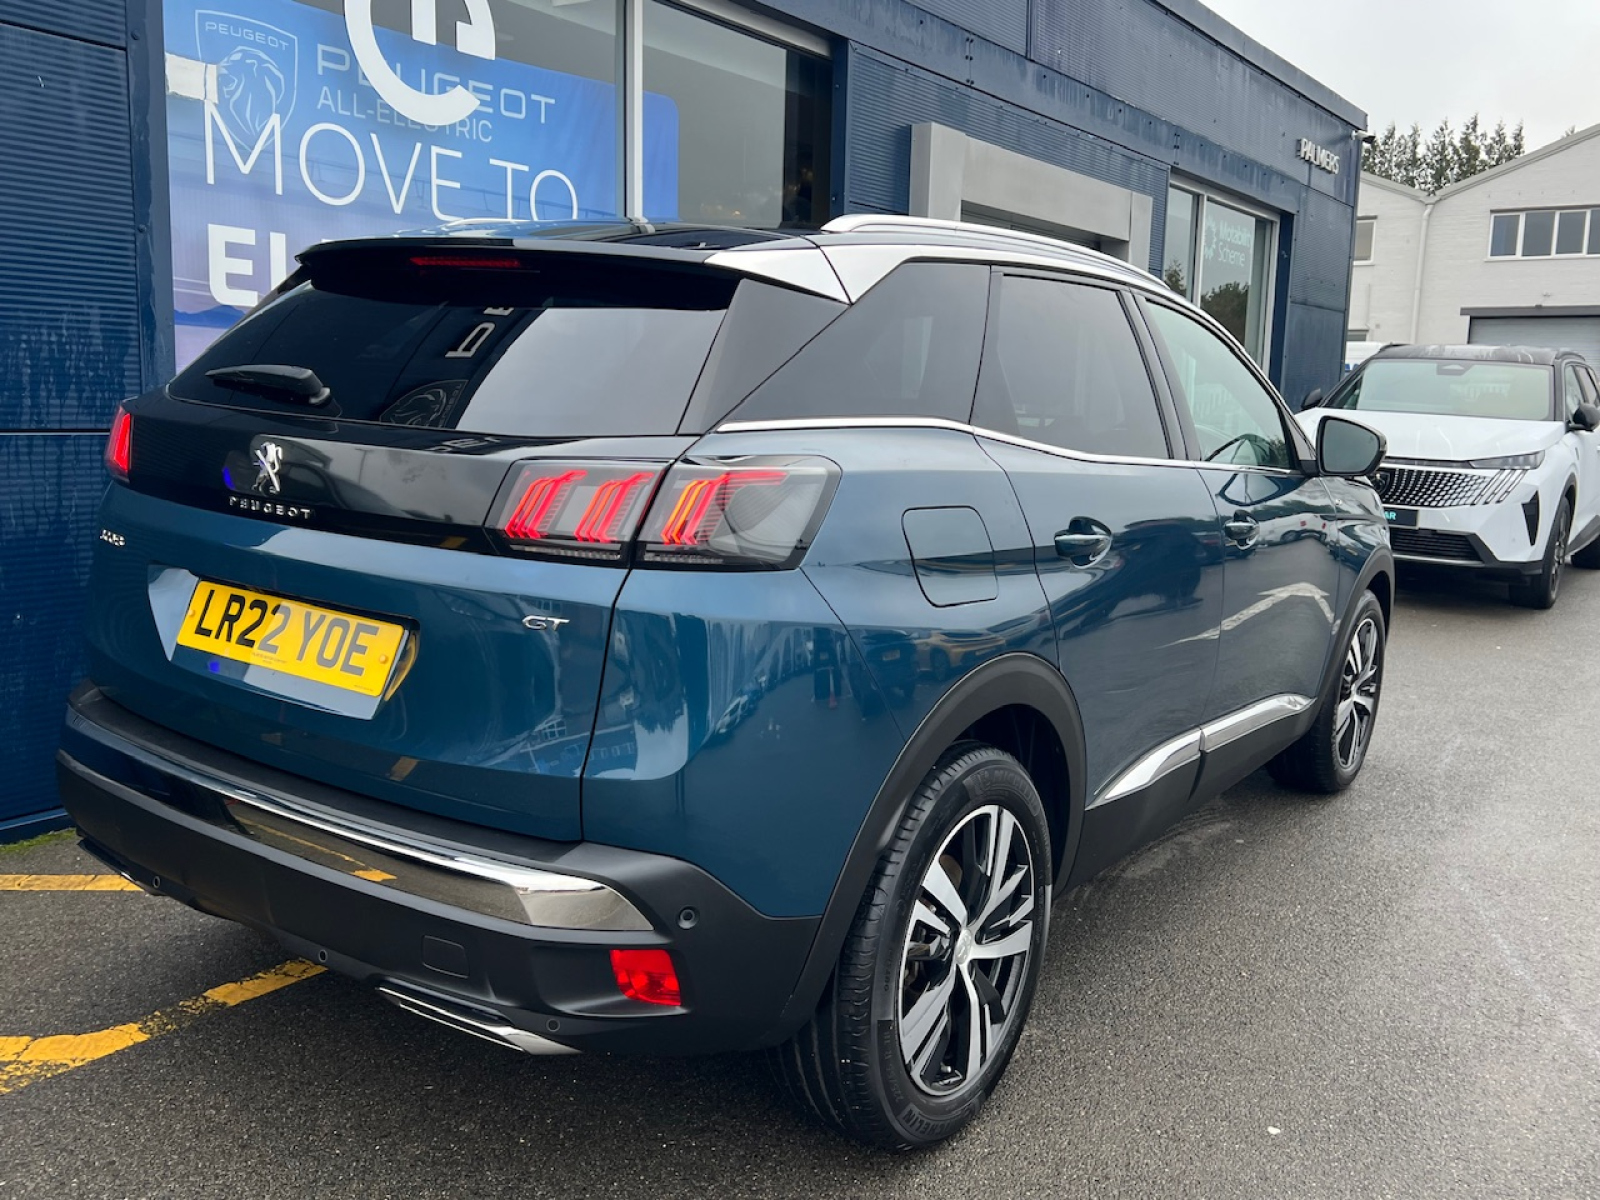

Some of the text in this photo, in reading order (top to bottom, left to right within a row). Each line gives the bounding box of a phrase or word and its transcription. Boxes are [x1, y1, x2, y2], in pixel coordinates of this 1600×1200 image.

[205, 21, 289, 51] PEUGEOT
[317, 85, 493, 143] ALL-ELRIC
[204, 99, 579, 222] MOVE TO
[1300, 138, 1340, 174] PALMERS
[229, 496, 311, 519] PEUGEOT
[194, 589, 380, 677] LR22 YOE
[522, 615, 570, 631] GT
